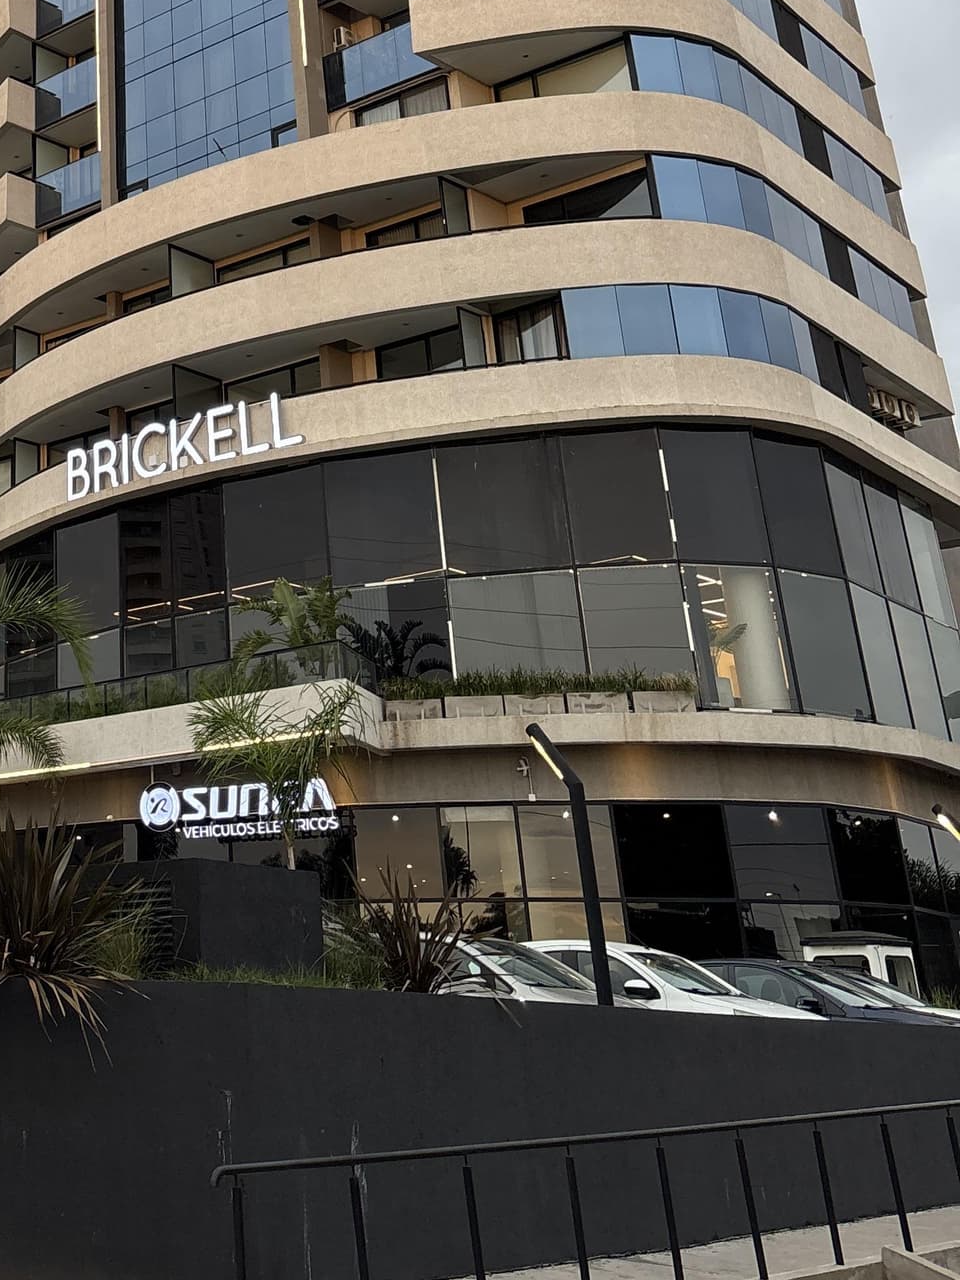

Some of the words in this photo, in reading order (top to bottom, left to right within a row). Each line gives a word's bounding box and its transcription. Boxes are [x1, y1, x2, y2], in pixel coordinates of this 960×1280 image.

[67, 392, 304, 501] BRICKELL
[182, 778, 337, 821] SUNA
[183, 822, 255, 839] VEHÍCULOS
